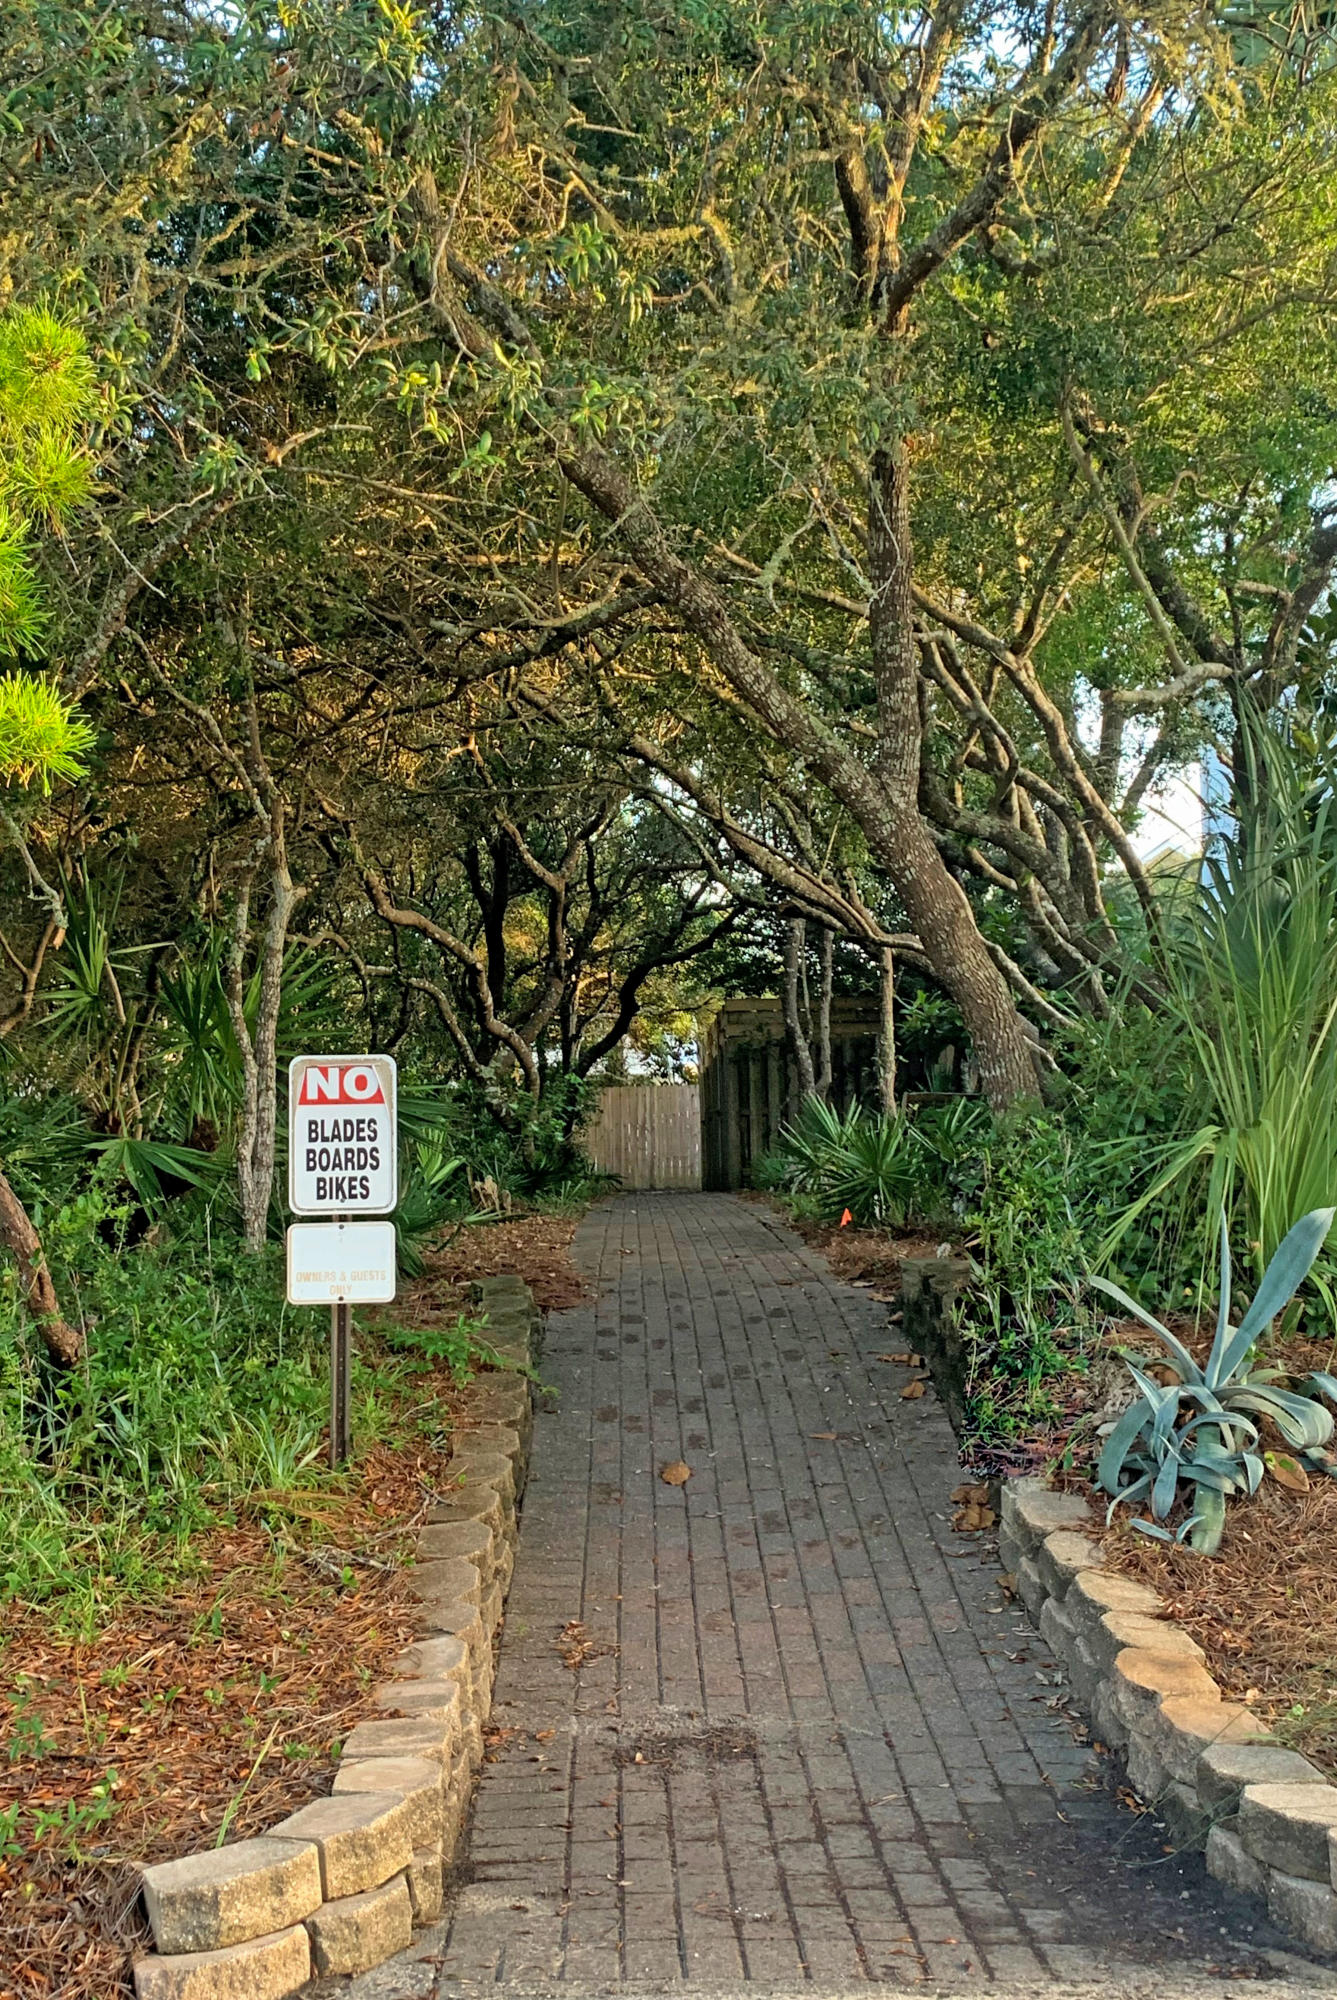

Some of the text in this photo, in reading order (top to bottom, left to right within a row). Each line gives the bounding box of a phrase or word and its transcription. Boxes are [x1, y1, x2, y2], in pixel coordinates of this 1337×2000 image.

[306, 1067, 379, 1100] NO
[308, 1118, 378, 1143] BLADES
[306, 1147, 380, 1172] BOARDS
[316, 1176, 370, 1200] BIKES
[296, 1270, 386, 1282] OWNERS & GUESTS
[329, 1284, 353, 1295] ONLY
